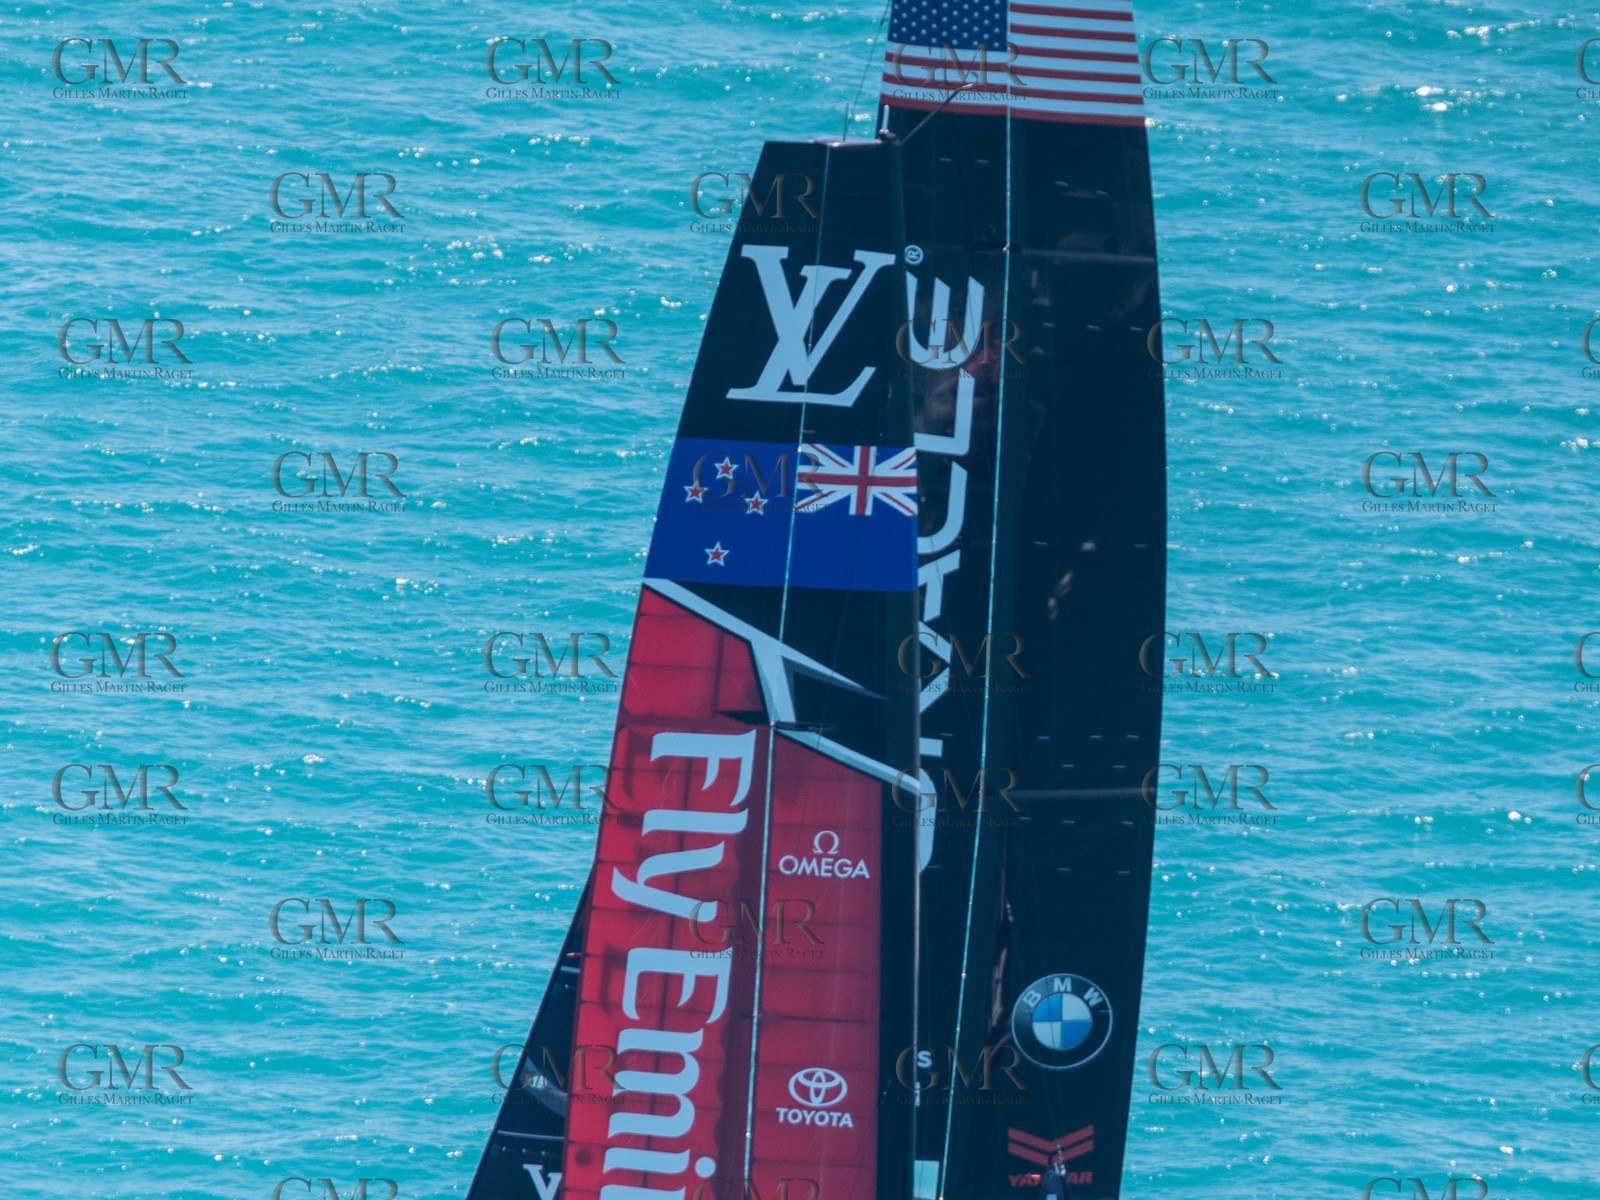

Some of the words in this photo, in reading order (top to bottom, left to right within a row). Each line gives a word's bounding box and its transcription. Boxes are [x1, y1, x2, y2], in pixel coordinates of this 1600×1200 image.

[779, 855, 870, 879] OMEGA
[1022, 977, 1103, 1008] BMW
[776, 1107, 853, 1128] TOYOTA
